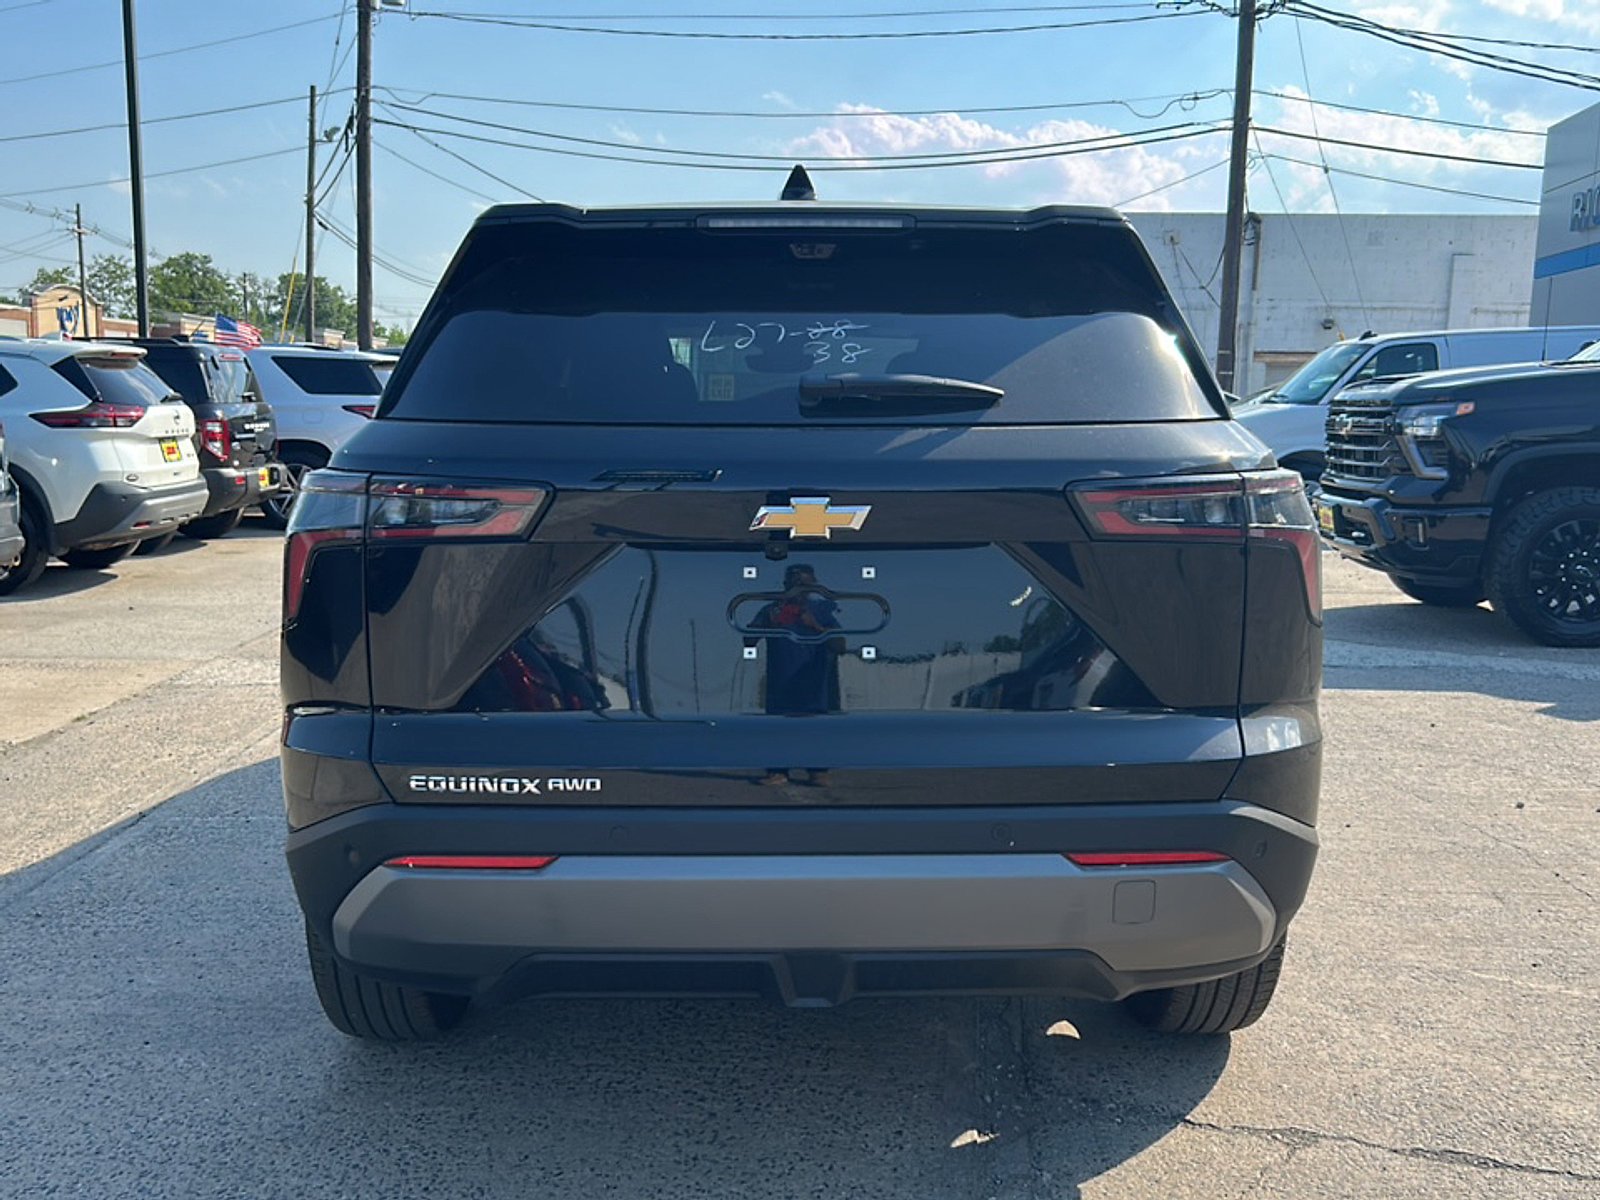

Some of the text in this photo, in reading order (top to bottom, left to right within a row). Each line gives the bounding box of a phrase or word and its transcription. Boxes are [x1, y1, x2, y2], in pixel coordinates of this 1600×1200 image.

[803, 341, 872, 365] 38
[408, 775, 602, 795] EQUINOX AWD
